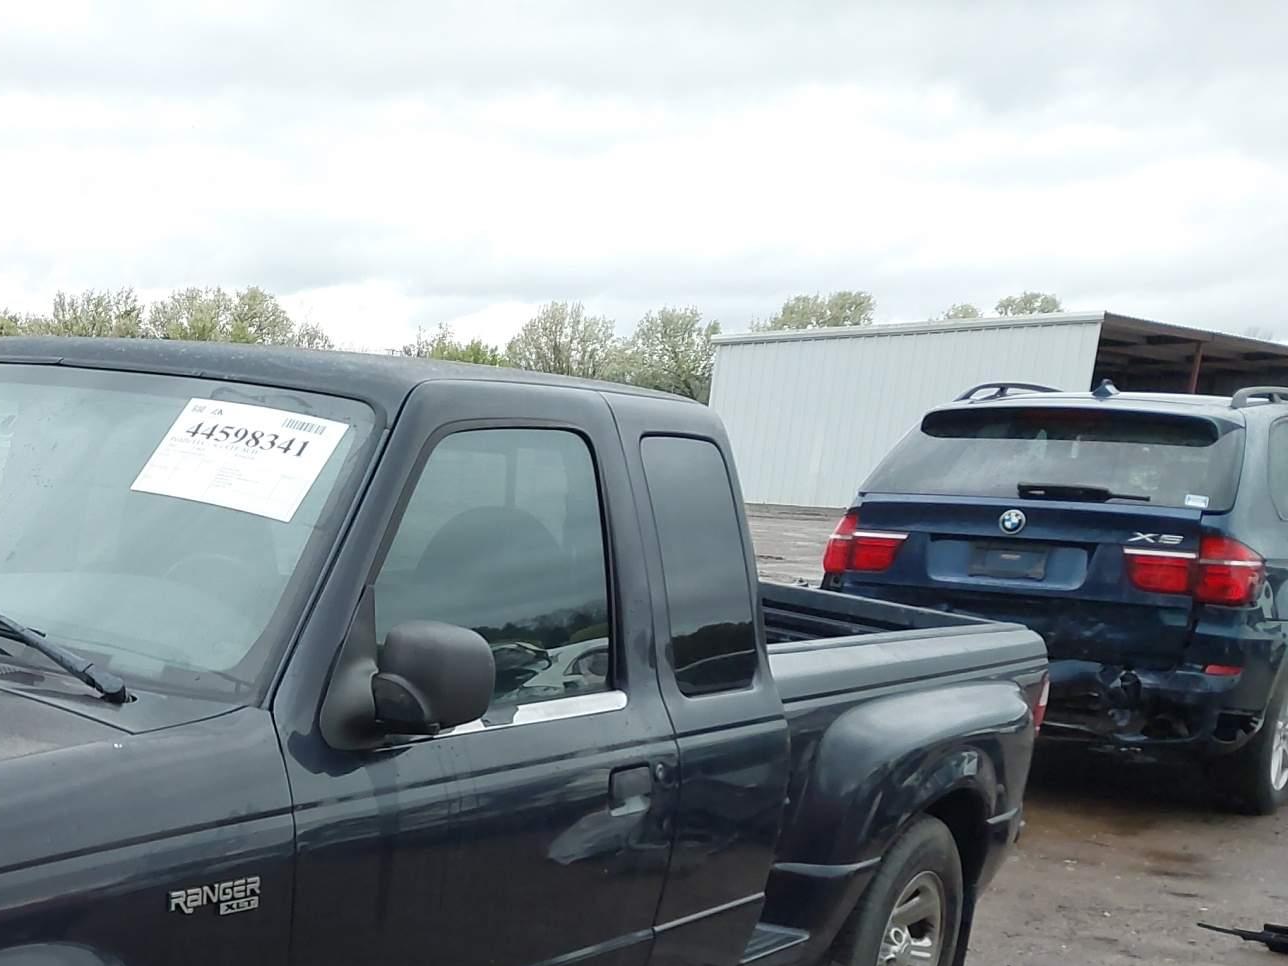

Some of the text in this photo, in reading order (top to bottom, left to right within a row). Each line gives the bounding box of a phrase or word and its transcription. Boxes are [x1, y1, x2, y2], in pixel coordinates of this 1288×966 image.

[185, 421, 311, 457] 44598341
[1128, 531, 1184, 544] X5
[169, 875, 261, 914] RANGER
[222, 898, 256, 913] XLT
